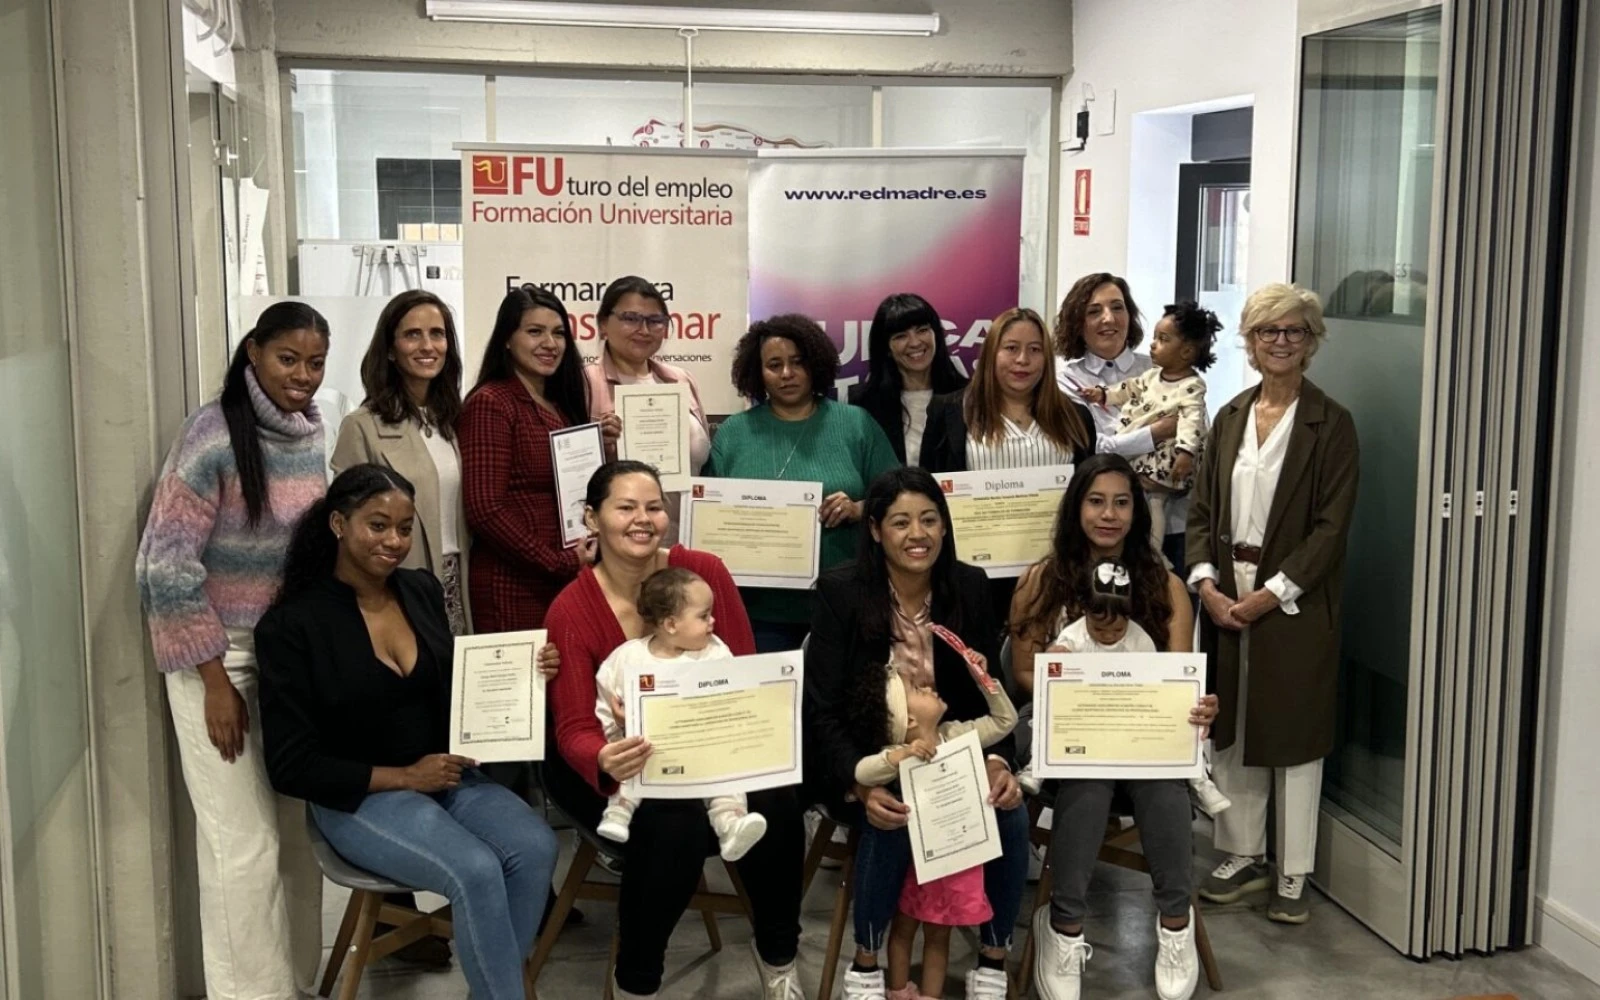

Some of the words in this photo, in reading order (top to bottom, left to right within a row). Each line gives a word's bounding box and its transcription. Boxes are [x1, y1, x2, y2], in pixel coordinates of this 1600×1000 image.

[618, 175, 648, 197] del
[655, 177, 733, 202] empleo
[784, 186, 987, 200] www.redmadre.es
[473, 200, 592, 223] Formación
[600, 202, 733, 225] Universitaria
[984, 480, 1025, 492] Diploma
[698, 678, 729, 689] DIPLOMA
